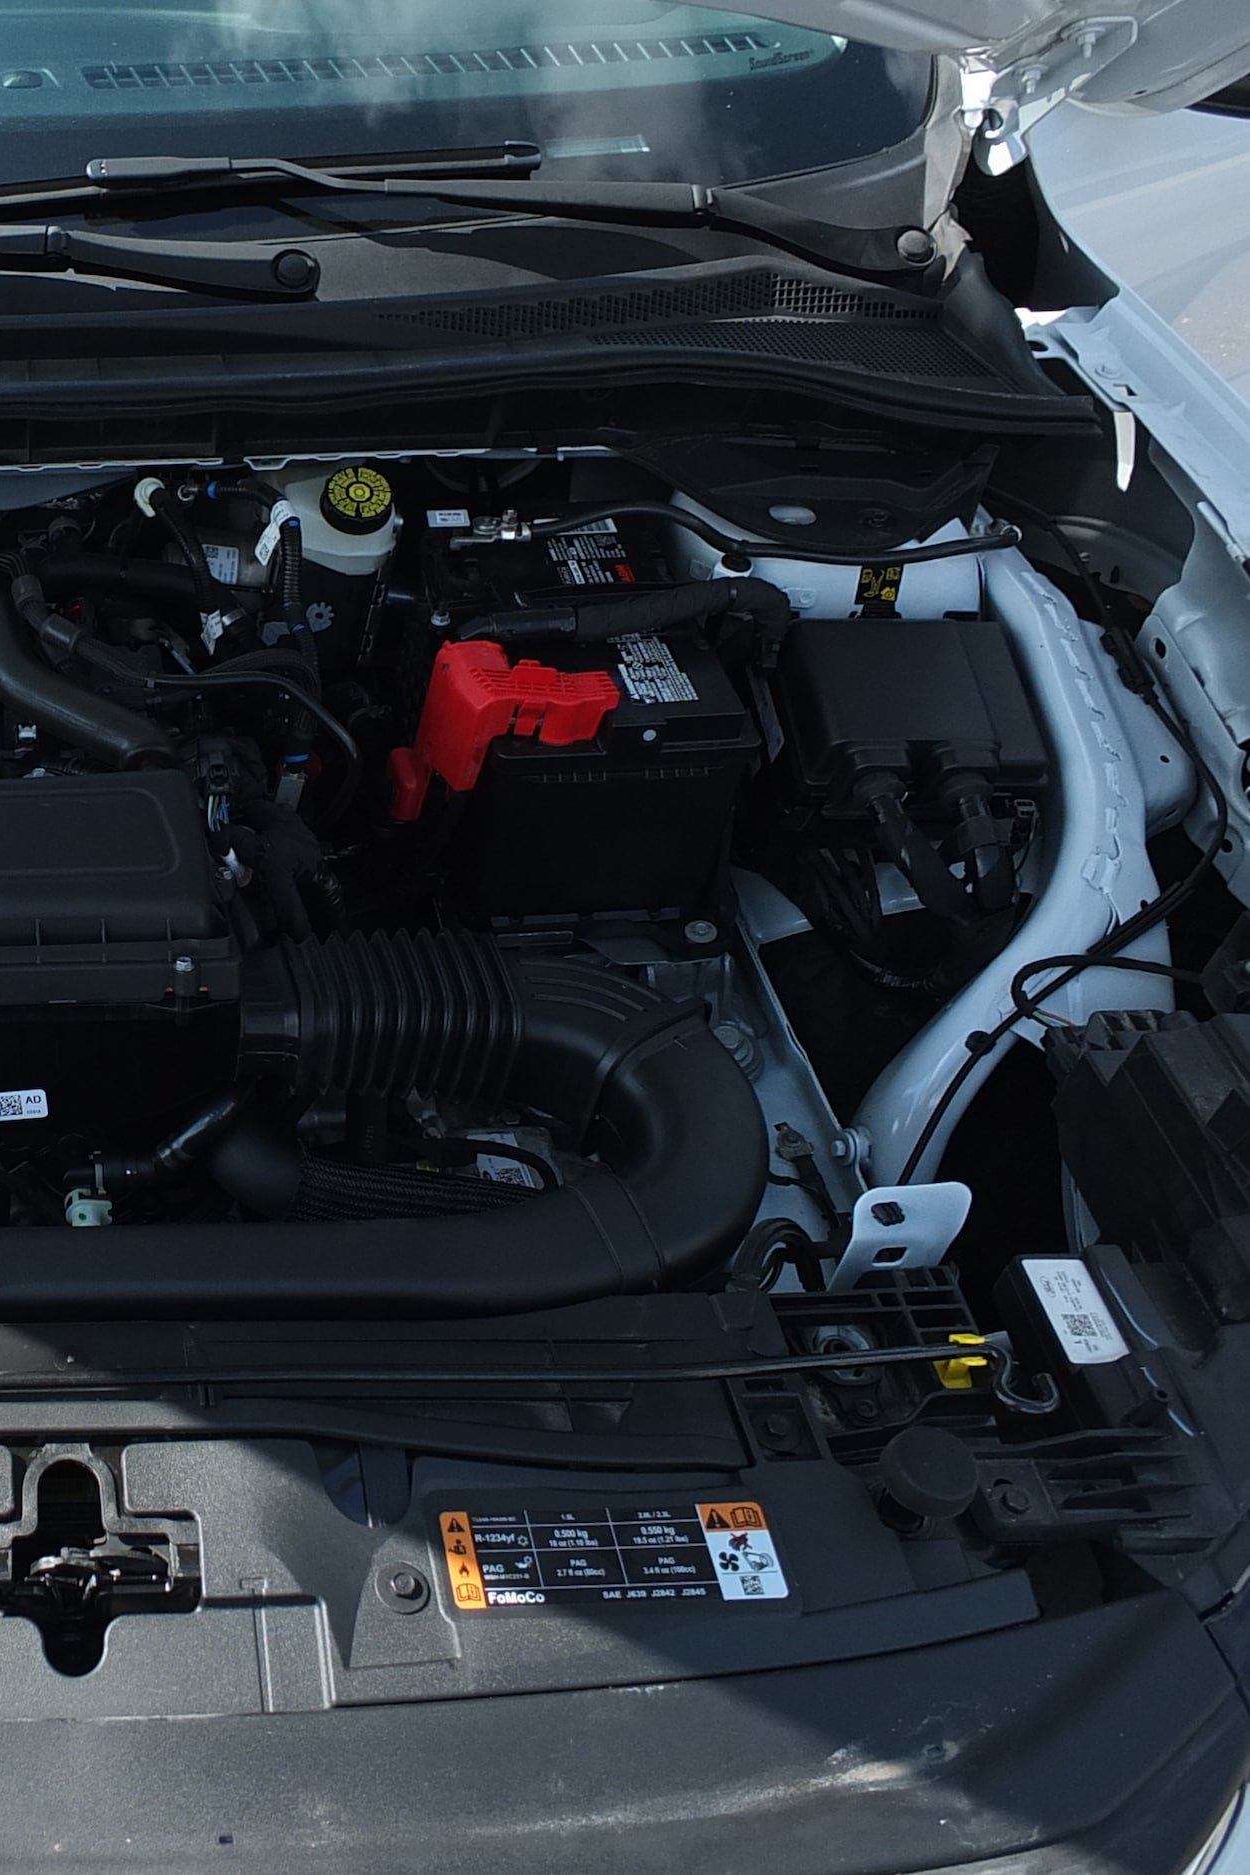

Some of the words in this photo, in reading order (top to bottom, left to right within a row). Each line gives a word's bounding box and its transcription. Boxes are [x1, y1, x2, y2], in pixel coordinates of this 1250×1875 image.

[25, 1095, 42, 1104] AD
[554, 1530, 576, 1538] 0.500
[576, 1528, 588, 1539] kg
[640, 1526, 663, 1535] 0.550
[663, 1525, 676, 1535] kg
[474, 1533, 515, 1544] R-1234yf
[570, 1559, 587, 1567] PAG
[657, 1557, 675, 1565] PAG
[482, 1564, 505, 1573] PAG
[487, 1591, 546, 1604] FoMoCo
[602, 1590, 622, 1599] SAE
